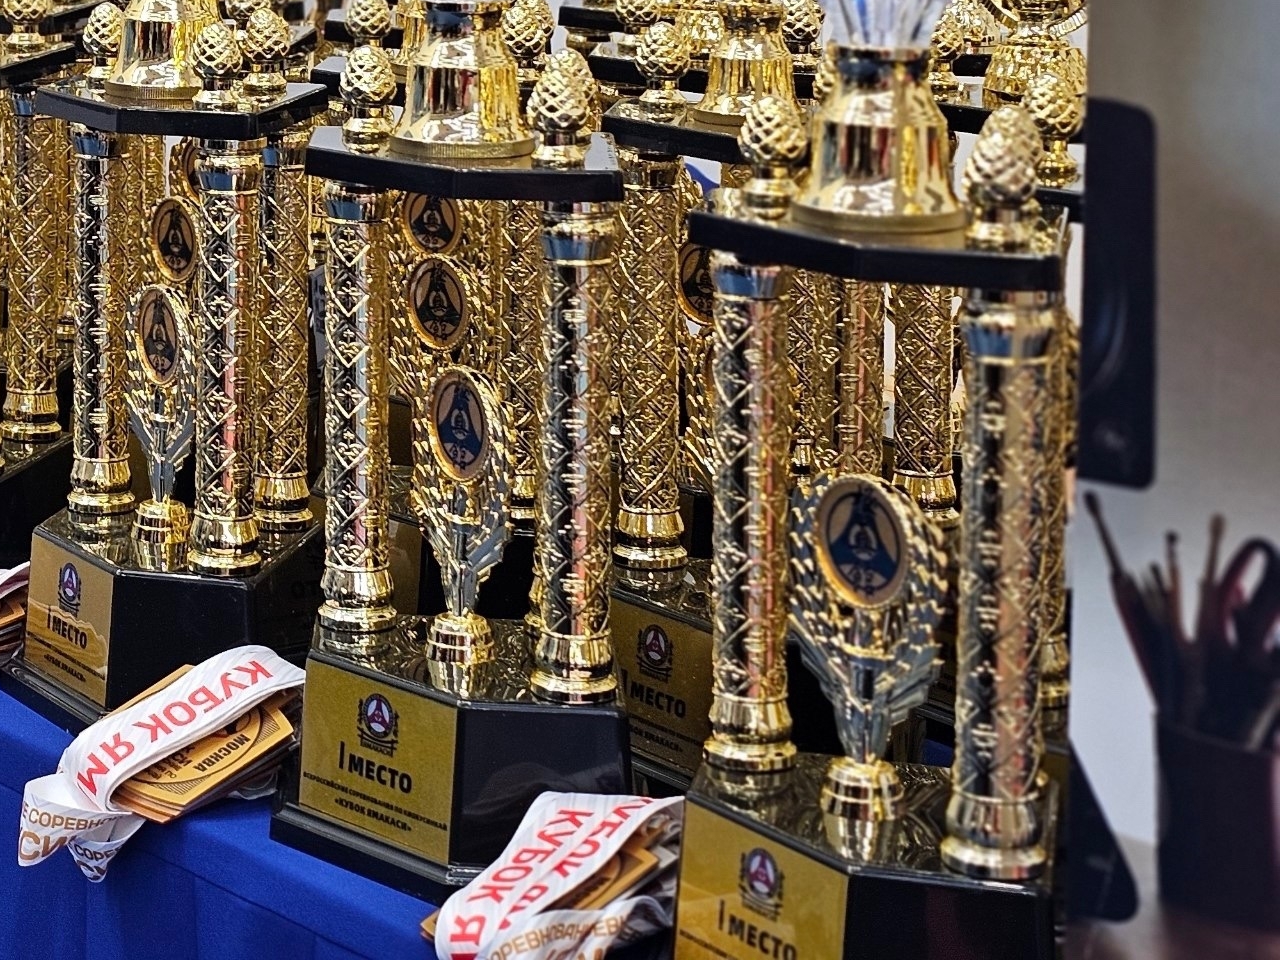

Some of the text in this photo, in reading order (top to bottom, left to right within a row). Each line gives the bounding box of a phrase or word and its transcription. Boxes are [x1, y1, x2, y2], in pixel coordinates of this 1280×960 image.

[52, 617, 88, 650] МЕСТО
[132, 660, 274, 743] КУБОК
[630, 680, 686, 719] МЕСТО
[192, 733, 252, 773] МОСКВА
[348, 753, 412, 794] МЕСТО
[467, 808, 595, 905] КУБОК
[728, 913, 798, 960] МЕСТО
